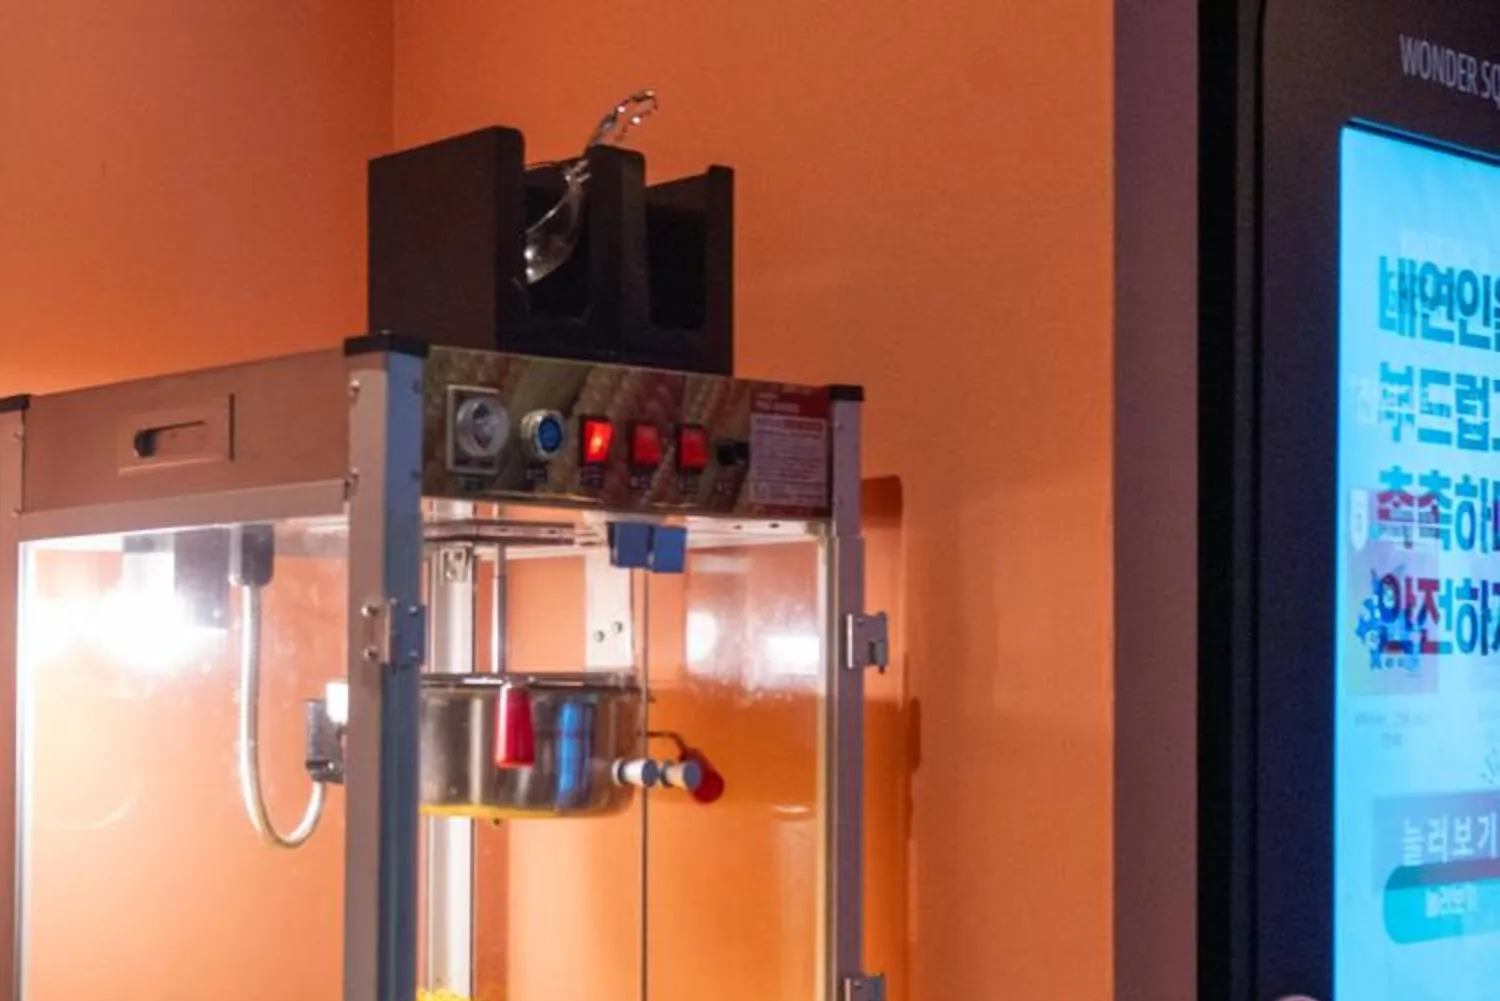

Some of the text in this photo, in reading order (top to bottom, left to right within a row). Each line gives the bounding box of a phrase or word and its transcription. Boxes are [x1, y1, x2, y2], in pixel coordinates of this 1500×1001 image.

[1400, 34, 1477, 96] WONDER
[1379, 361, 1500, 452] 부드럽
[1377, 465, 1500, 554] 촉촉하
[1377, 572, 1500, 658] 안전하
